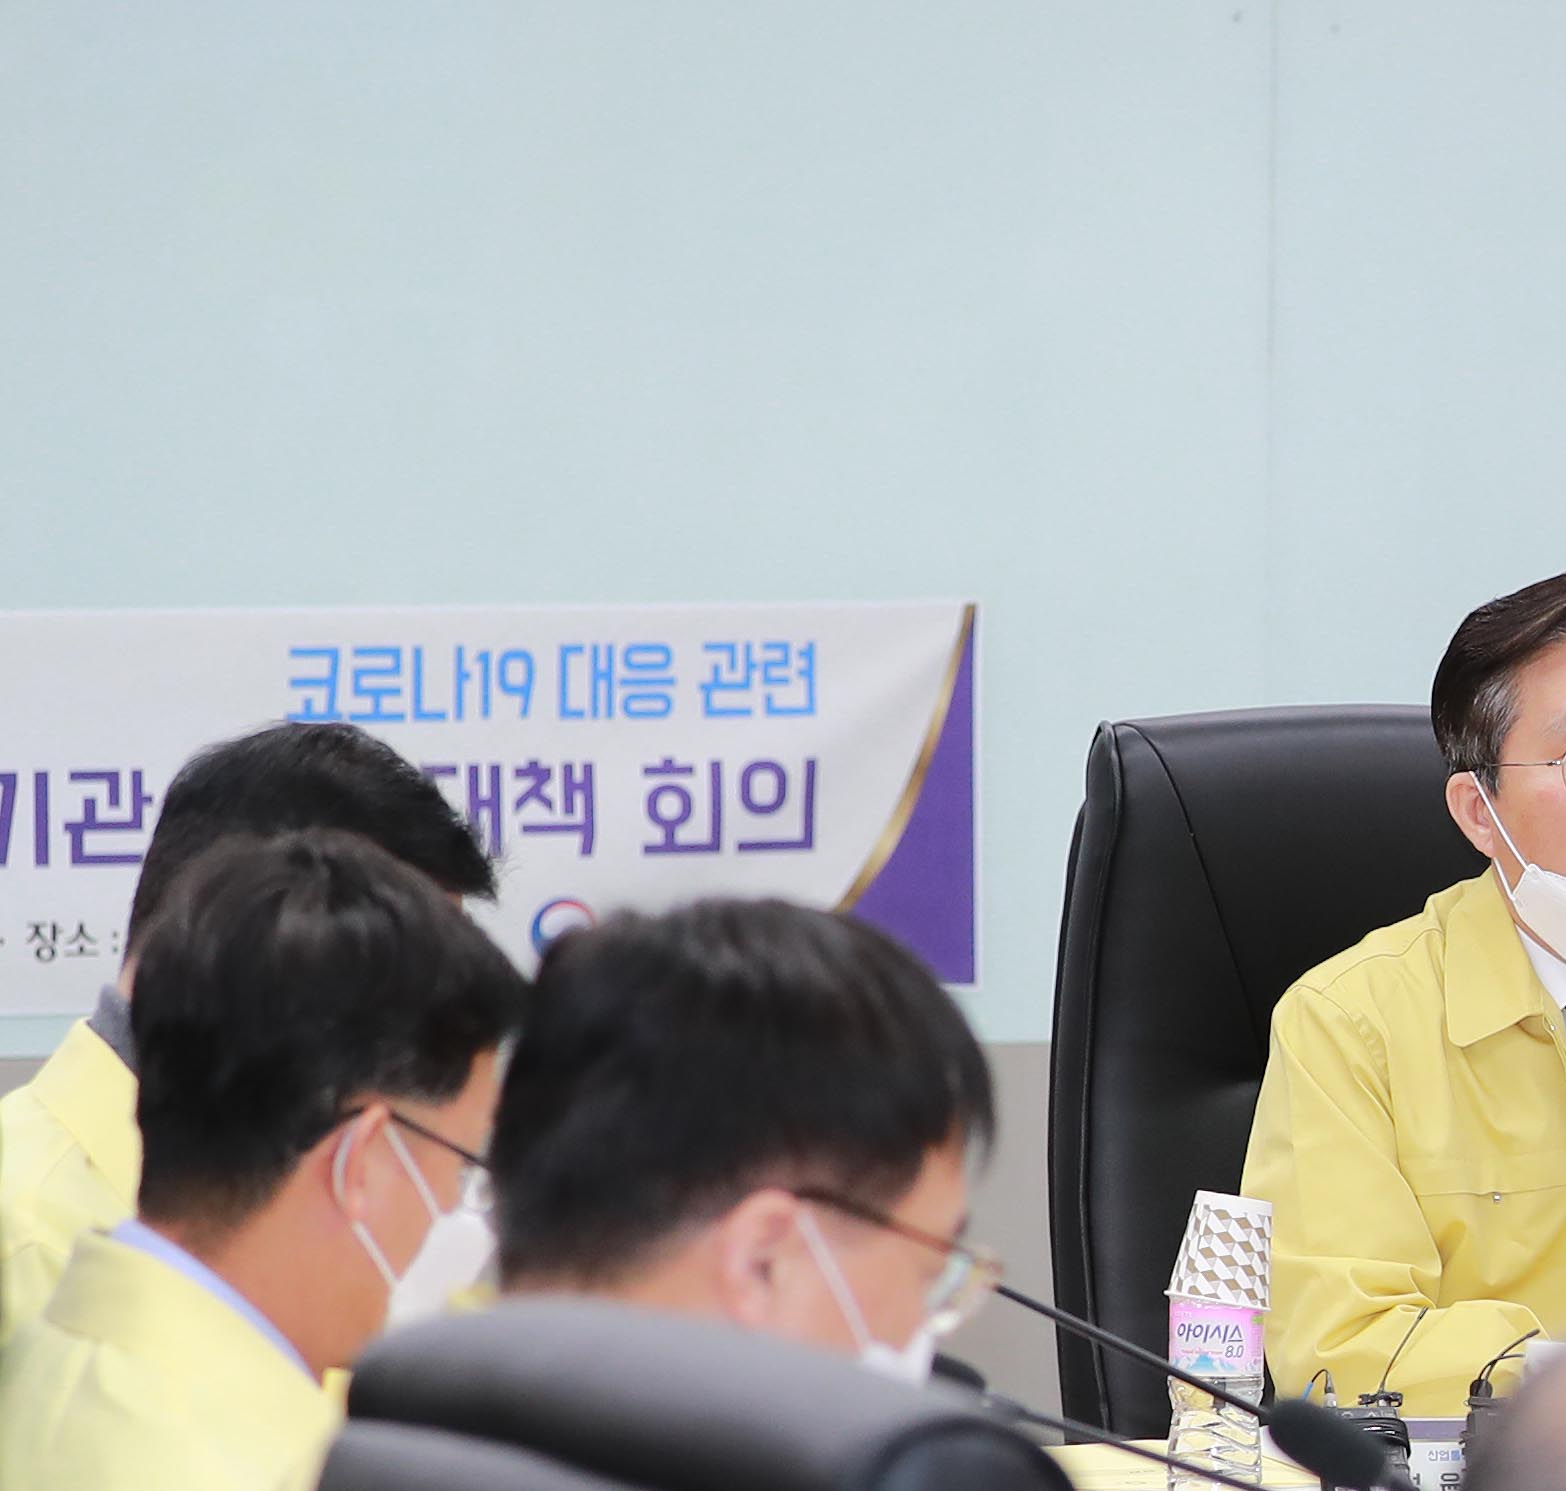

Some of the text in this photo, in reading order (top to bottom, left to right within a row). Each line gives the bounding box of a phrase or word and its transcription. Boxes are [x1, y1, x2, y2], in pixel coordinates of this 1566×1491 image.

[286, 641, 816, 721] 코로나19 대응 관련
[643, 758, 817, 856] 회의
[1177, 1322, 1244, 1344] 아이시스
